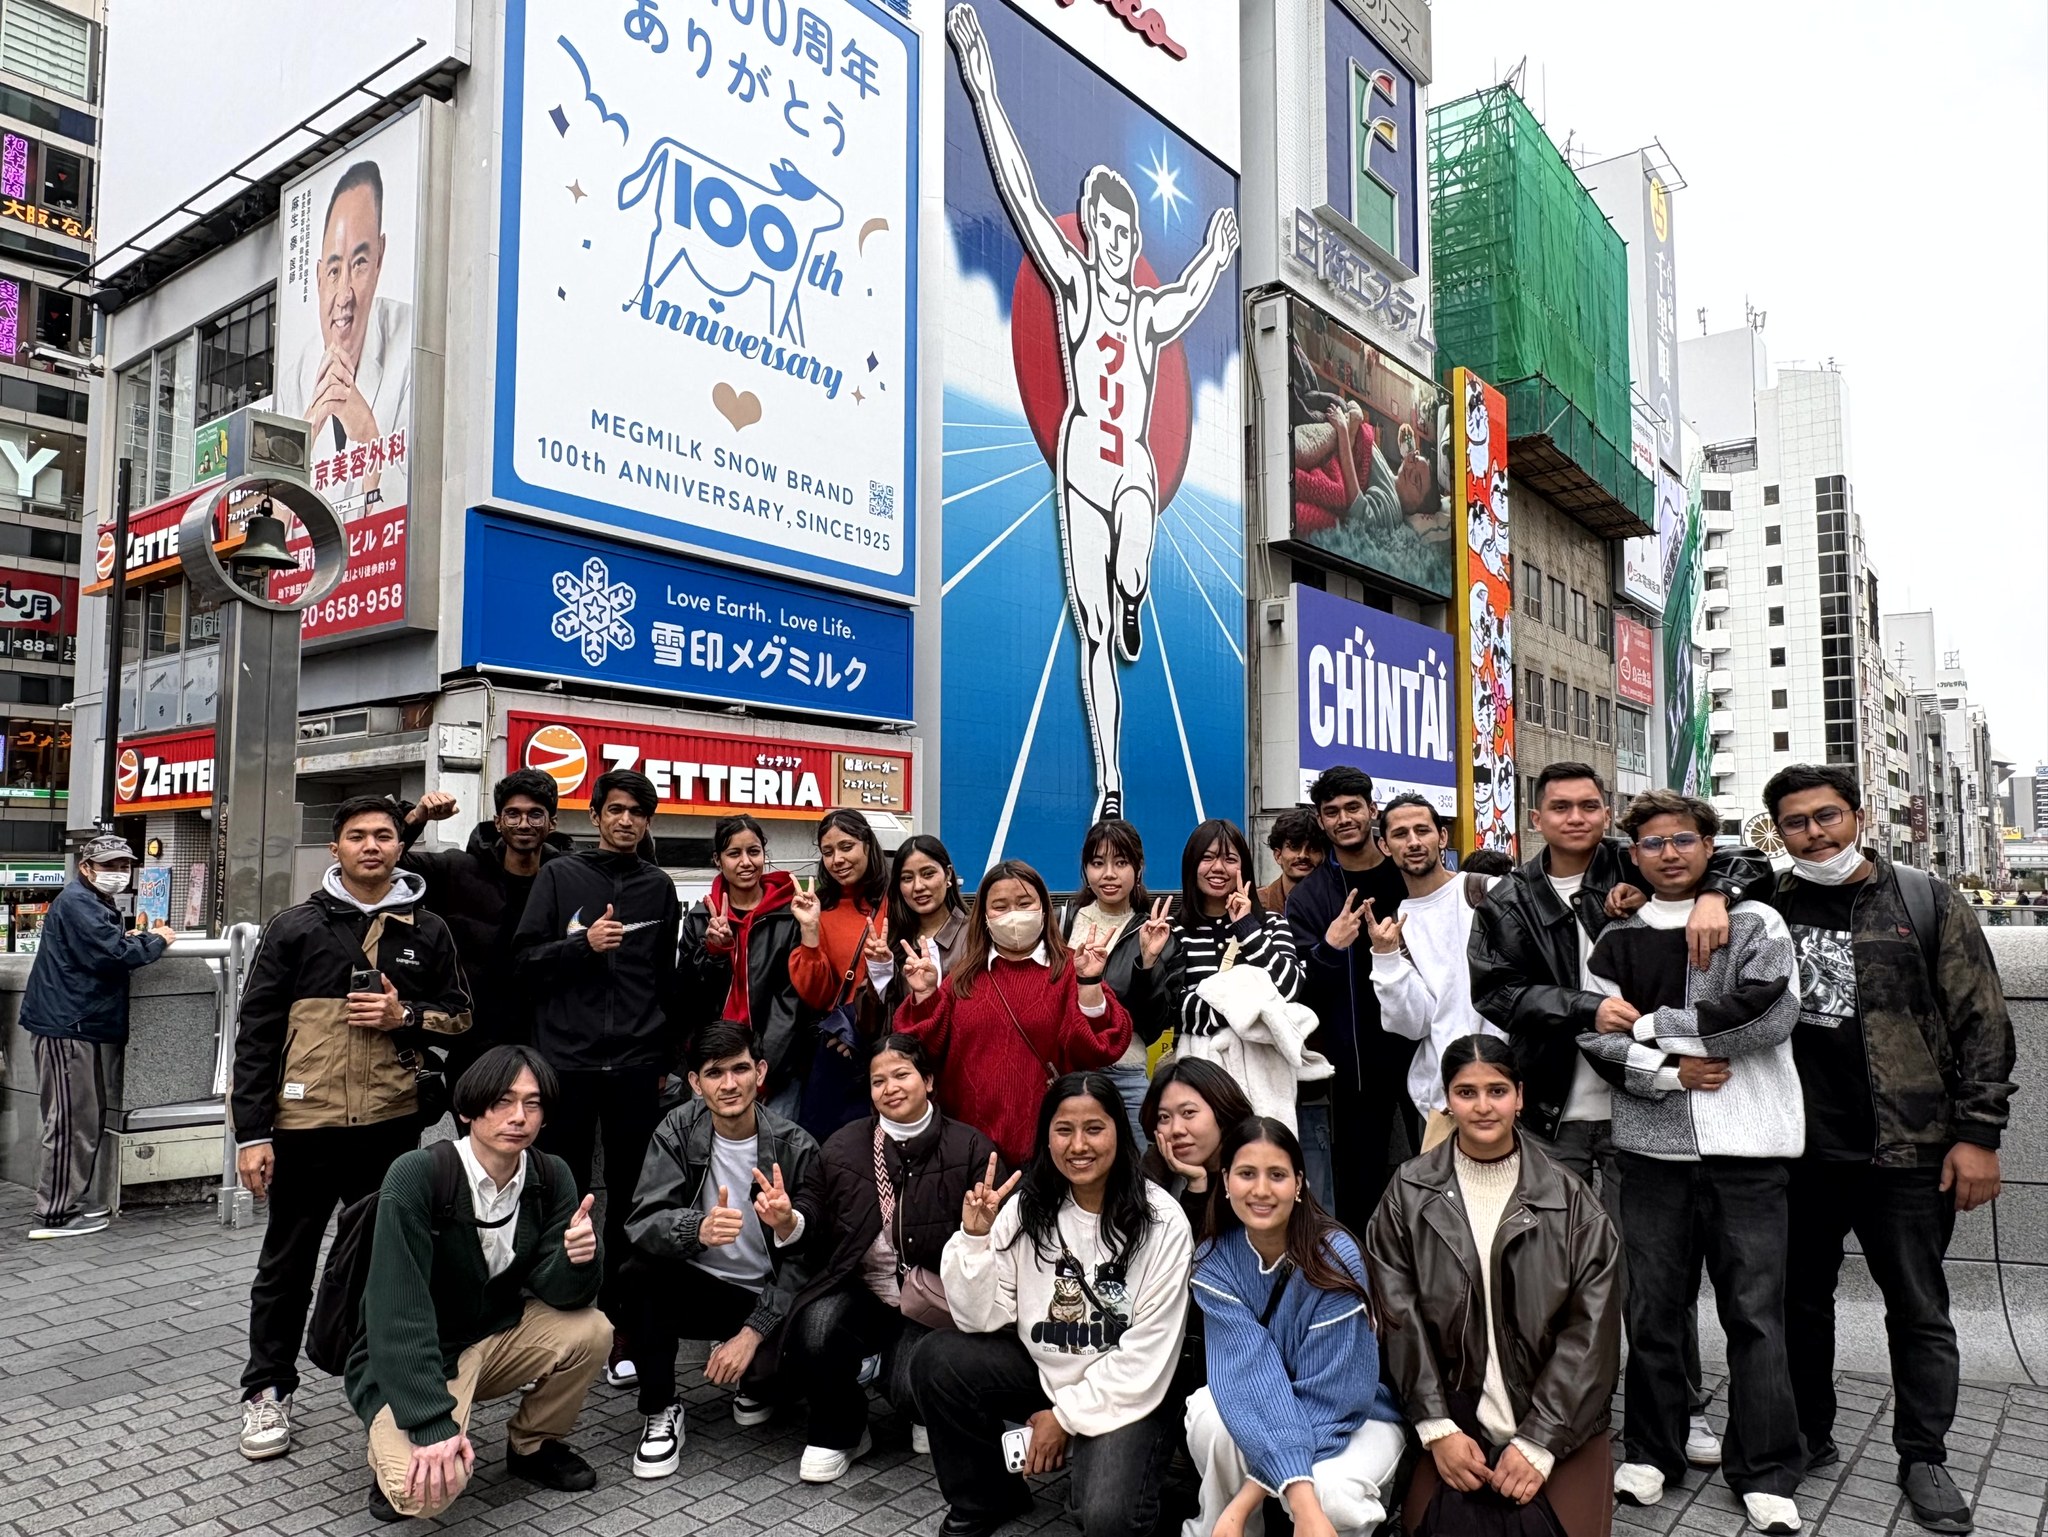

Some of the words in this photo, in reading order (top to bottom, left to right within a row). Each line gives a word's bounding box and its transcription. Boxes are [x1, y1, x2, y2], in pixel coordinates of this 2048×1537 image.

[624, 0, 846, 157] ありがとう
[622, 283, 843, 399] Anniversary
[1096, 331, 1128, 467] グリコ
[313, 429, 406, 490] 京美容外科
[538, 437, 606, 475] 100th
[591, 409, 702, 461] MEGMILK
[714, 447, 778, 483] SNOW
[787, 470, 853, 506] BRAND
[382, 520, 405, 548] 2F
[667, 585, 710, 612] Love
[716, 595, 772, 622] Earth.
[780, 608, 817, 633] Love
[822, 615, 857, 639] Life.
[651, 621, 867, 692] 雪印メグミルク
[1308, 626, 1448, 762] CHINTAI
[141, 756, 215, 797] ZETTE
[602, 743, 823, 808] ZETTERIA
[756, 753, 802, 768] ゼッテリア
[843, 779, 888, 791] フェアトレード
[862, 793, 899, 804] コーヒー
